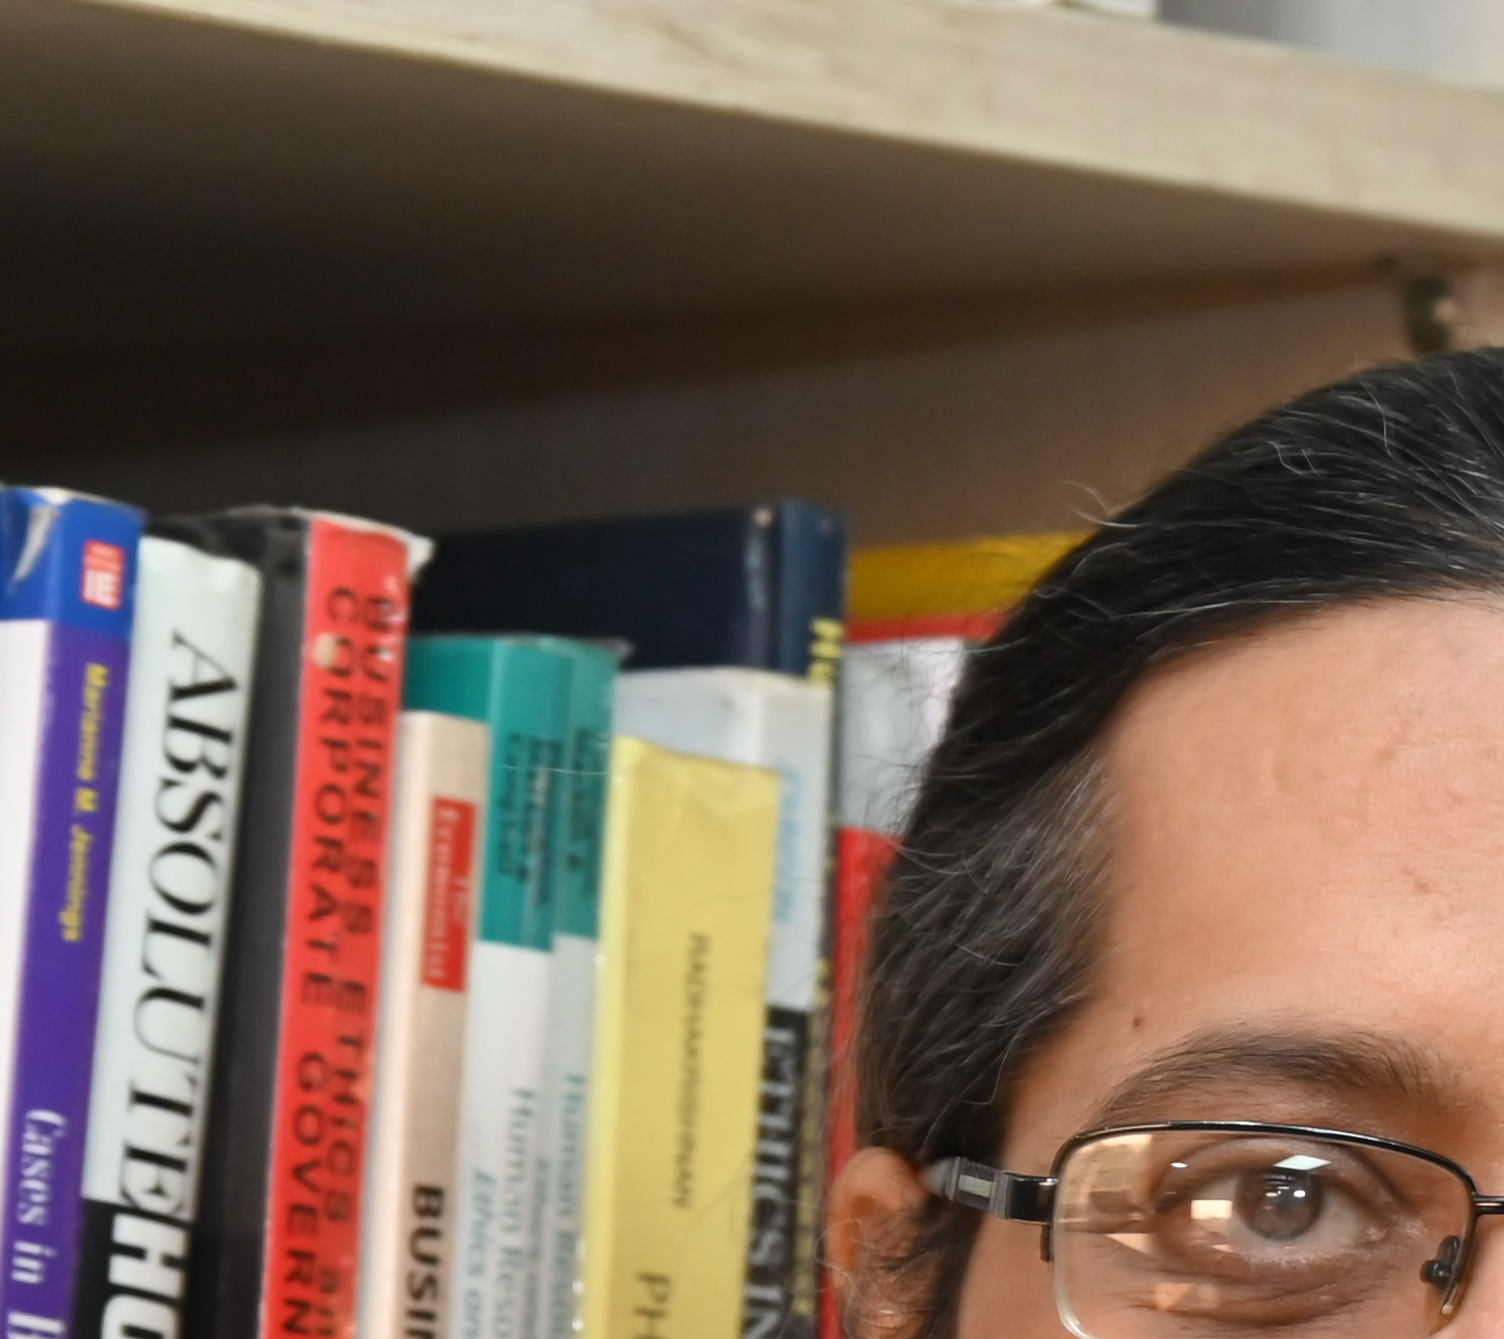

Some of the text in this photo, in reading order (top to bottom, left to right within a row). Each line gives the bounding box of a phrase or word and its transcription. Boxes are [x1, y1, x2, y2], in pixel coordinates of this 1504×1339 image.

[301, 588, 356, 1010] CORPORATE
[117, 630, 242, 1224] ABSOLUTE
[14, 1108, 67, 1226] Cases
[324, 980, 369, 1226] ETHICS
[11, 1240, 58, 1285] in
